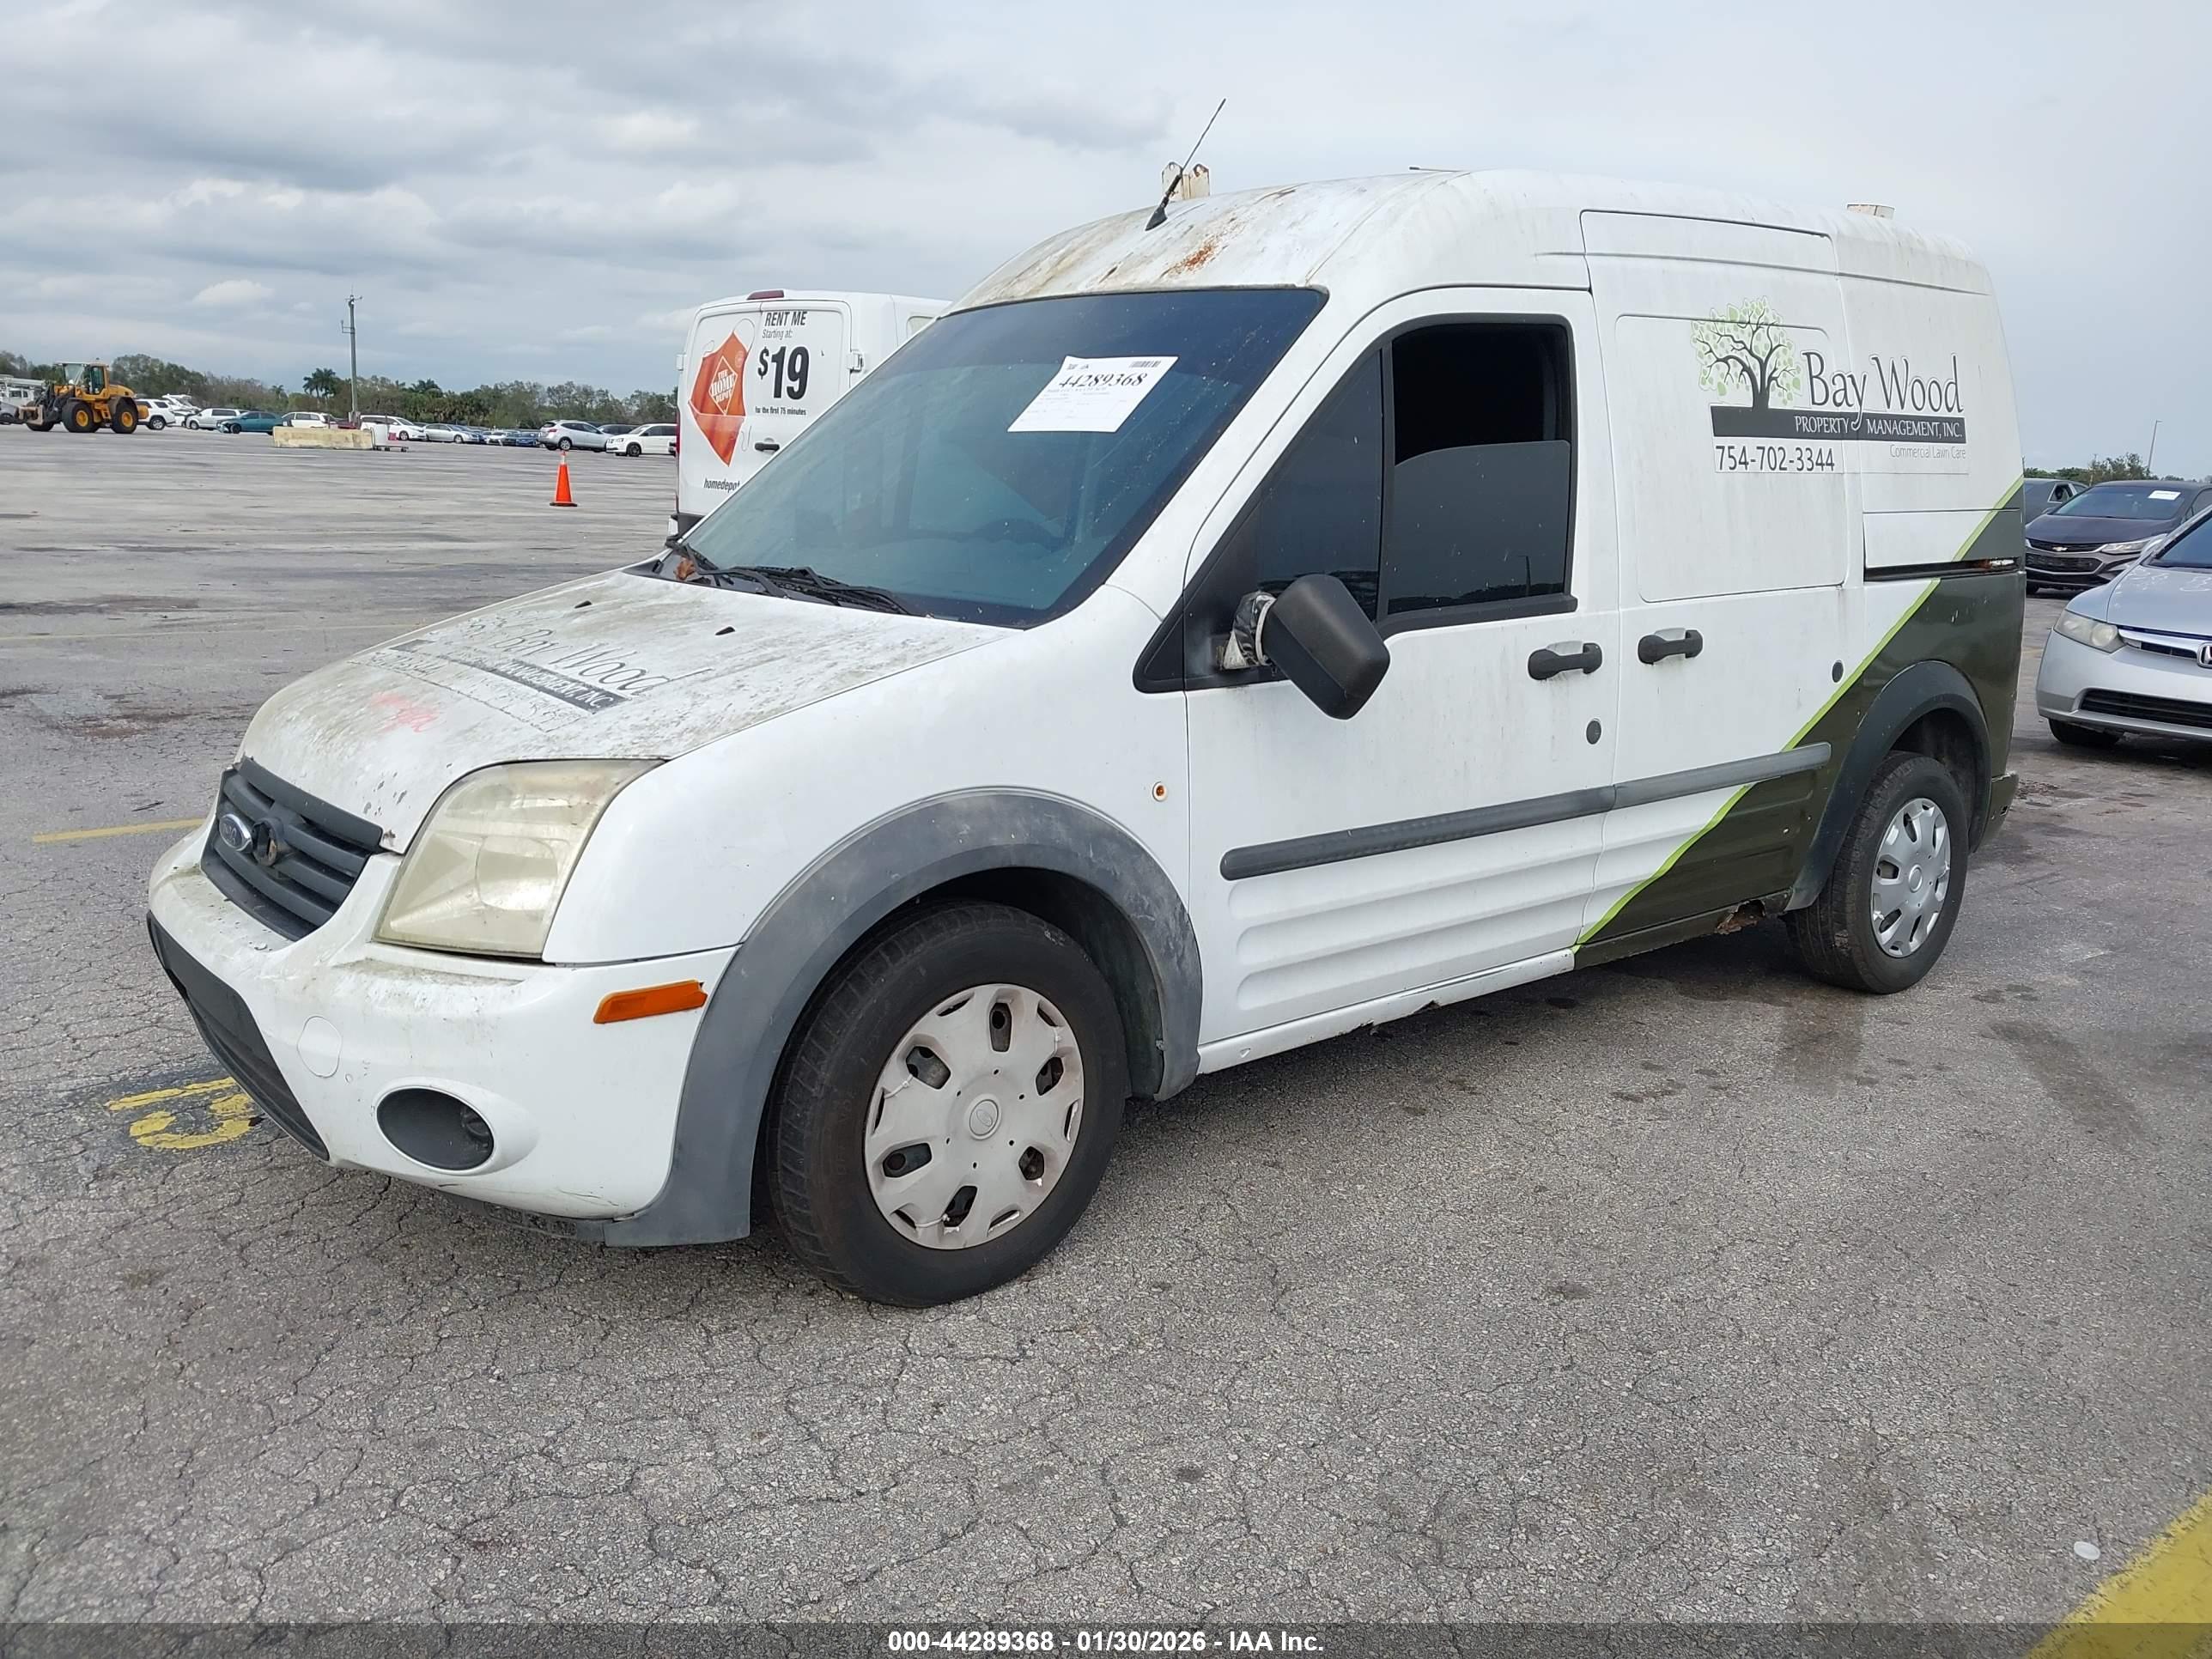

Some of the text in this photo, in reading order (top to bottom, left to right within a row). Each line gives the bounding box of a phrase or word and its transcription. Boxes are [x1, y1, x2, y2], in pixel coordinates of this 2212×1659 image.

[765, 311, 807, 326] RENT ME
[763, 329, 785, 341] Starting
[757, 346, 810, 400] $19
[1059, 373, 1148, 387] 44289368
[1802, 351, 1964, 431] Bay Wood
[787, 407, 807, 416] minutes
[1795, 416, 1964, 439] PROPERTY MANAGEMENT, INC.
[1715, 445, 1835, 471] 754-702-3344
[1890, 444, 1966, 459] Commercial Lawn Care
[548, 642, 714, 696] Wood
